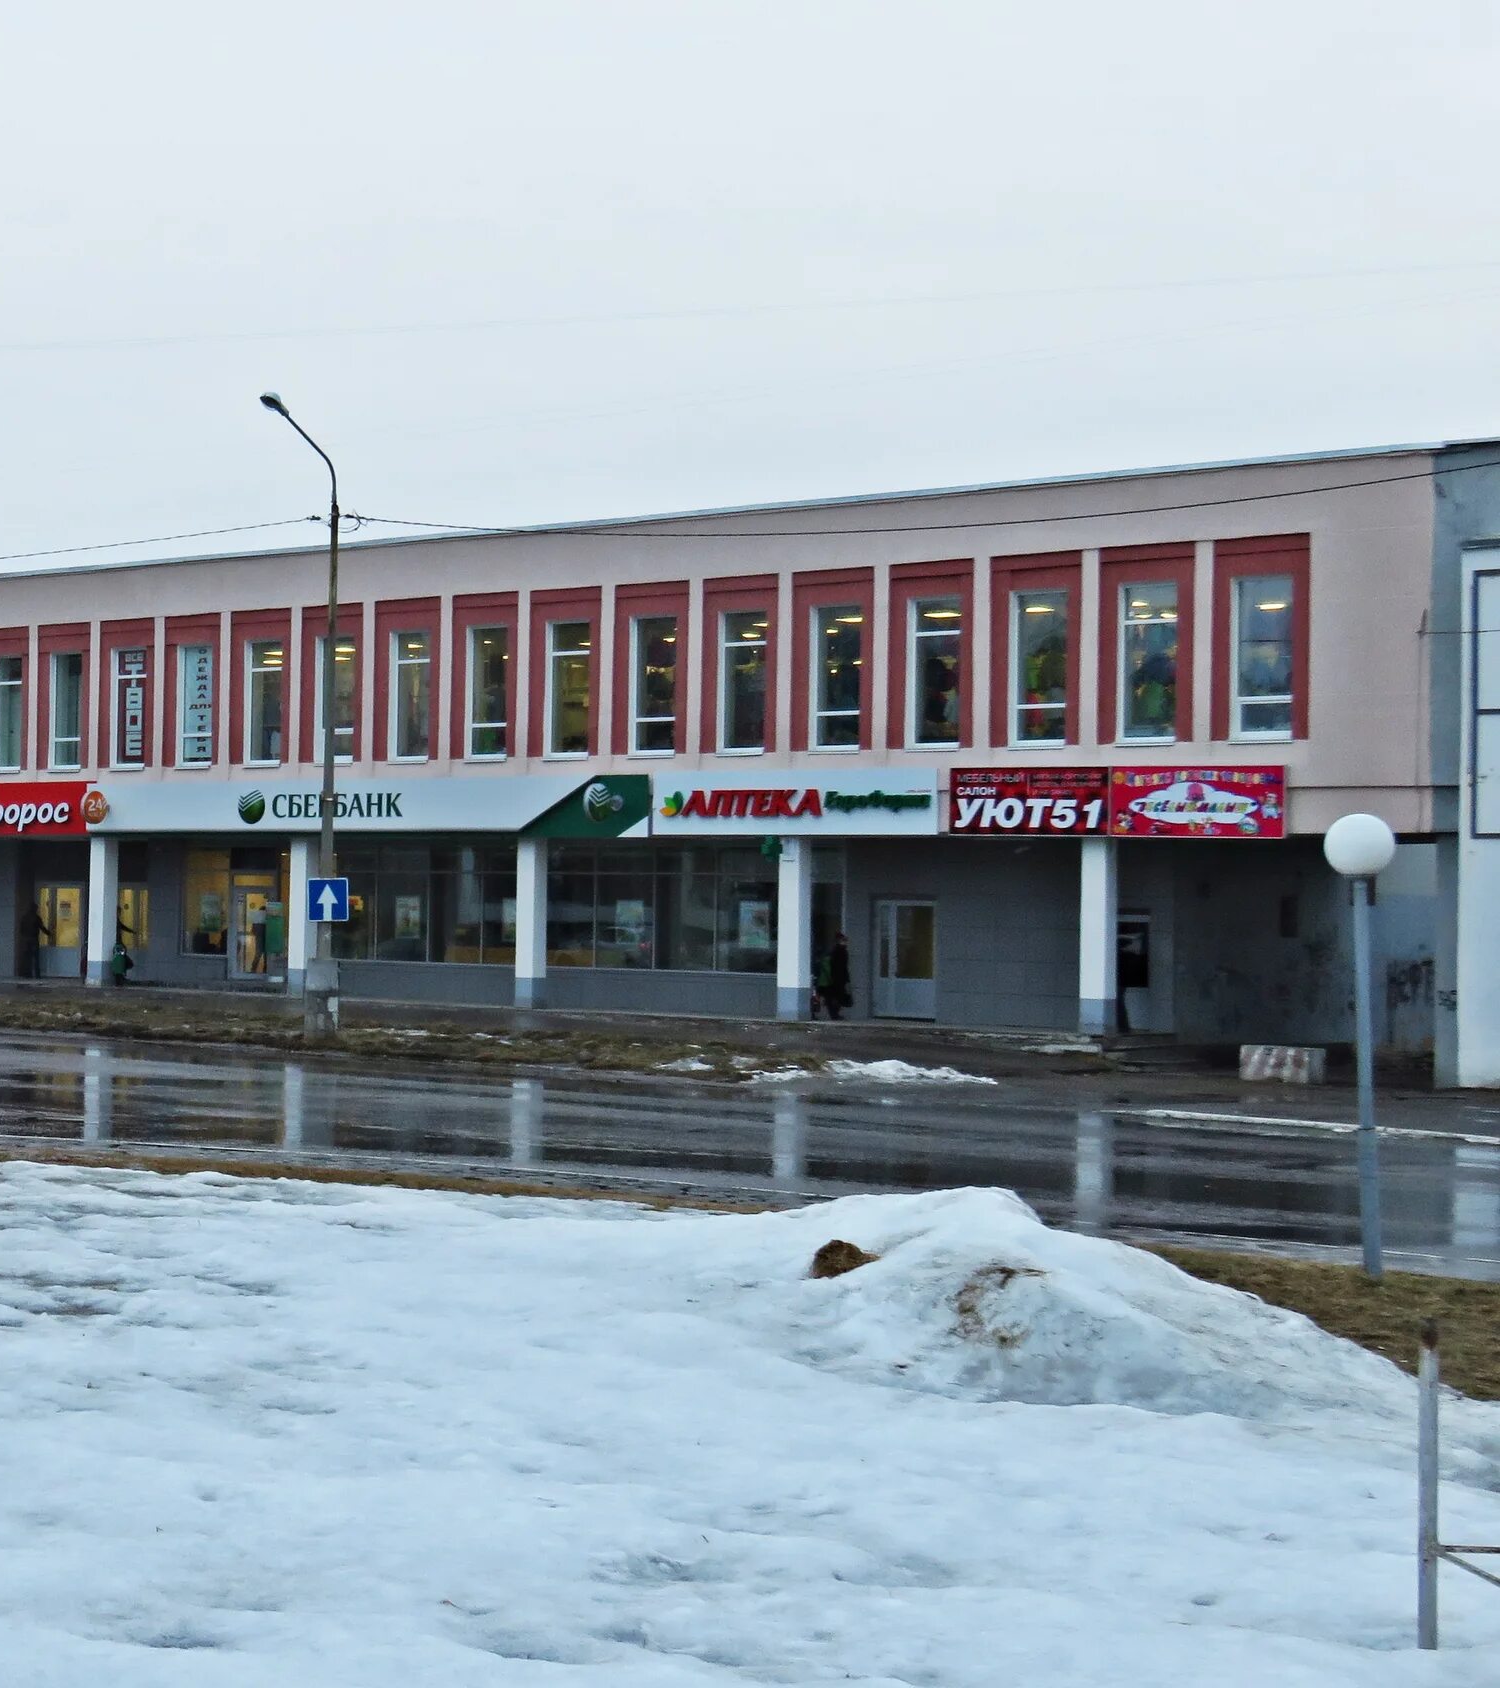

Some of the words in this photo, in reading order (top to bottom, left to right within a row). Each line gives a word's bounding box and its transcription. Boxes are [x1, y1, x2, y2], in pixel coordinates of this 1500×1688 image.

[196, 648, 207, 699] ОДЕЖДА
[125, 663, 143, 756] ТВОЕ
[956, 771, 1025, 783] МЕБЕЛЬНЫЙ
[956, 786, 997, 796] САЛОН
[680, 789, 823, 817] АПТЕКА
[954, 797, 1103, 829] УЮТ51
